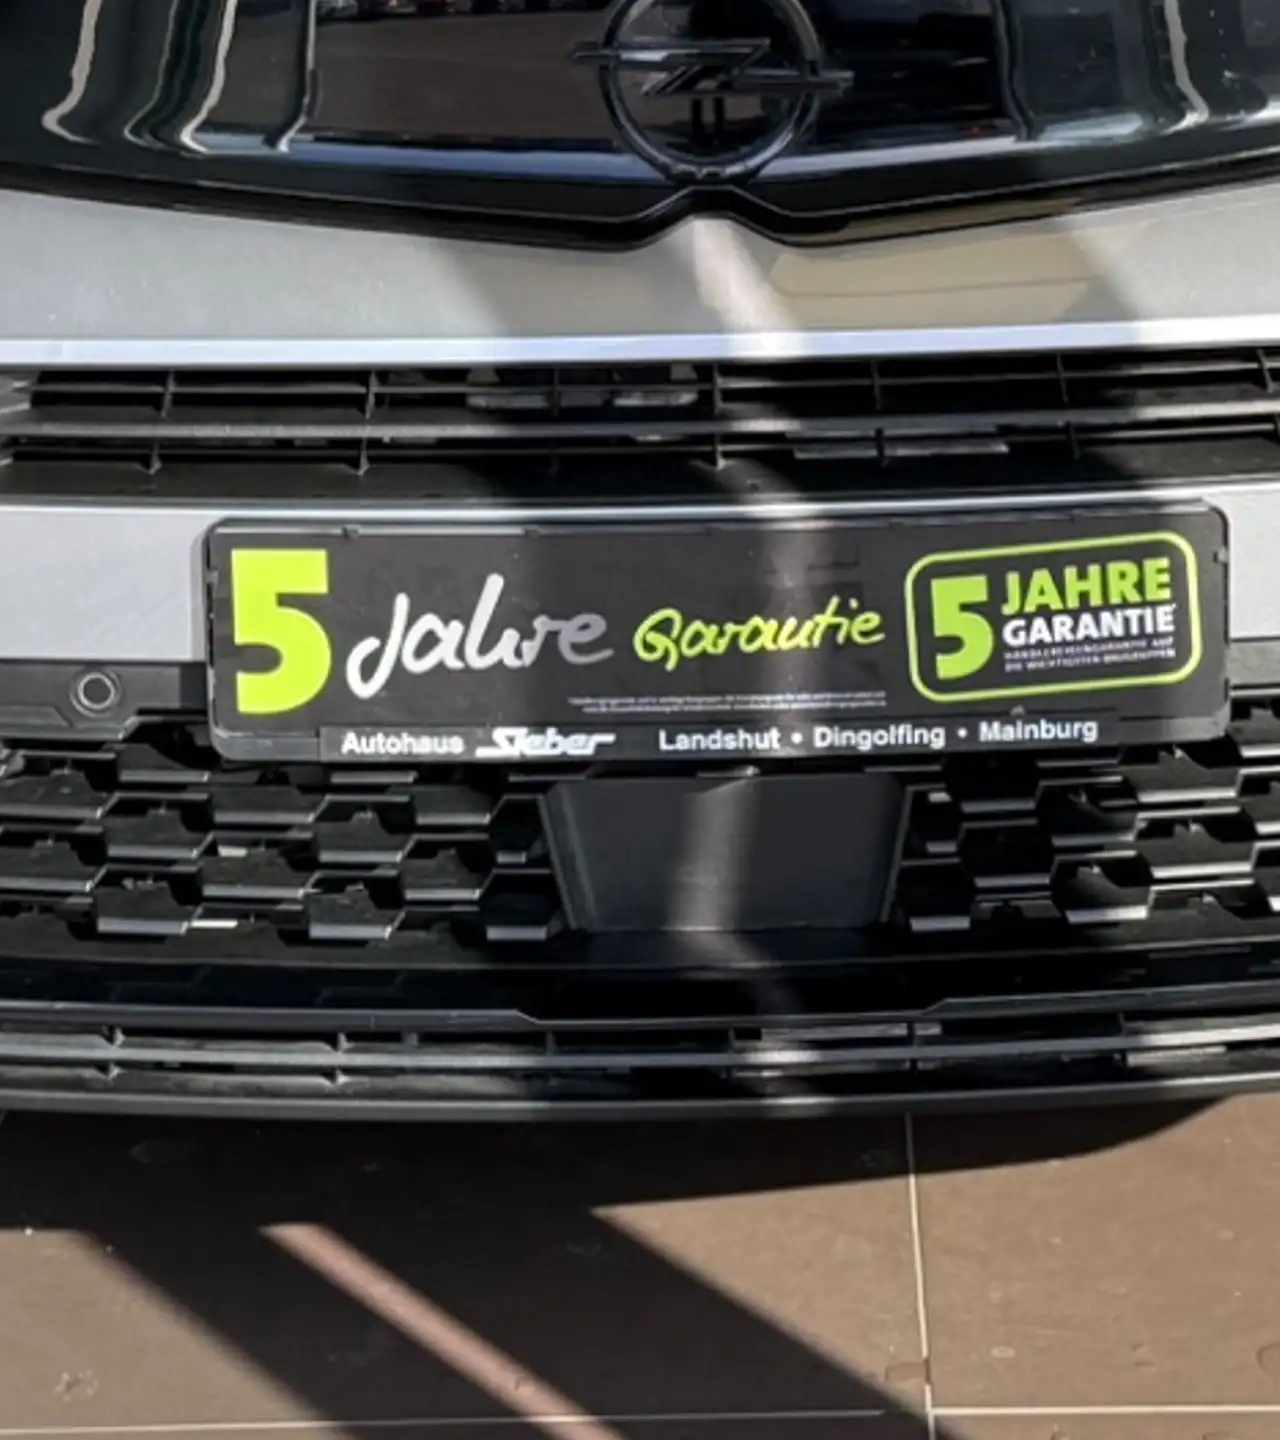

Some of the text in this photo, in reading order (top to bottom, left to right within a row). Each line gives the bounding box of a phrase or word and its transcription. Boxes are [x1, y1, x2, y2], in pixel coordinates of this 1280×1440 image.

[931, 574, 994, 680] 5
[1001, 557, 1171, 616] JAHRE
[231, 548, 886, 715] 5 Jahre Garantie
[341, 720, 1098, 757] Autohaus Sieber Landshut Dingolfing Mainburg
